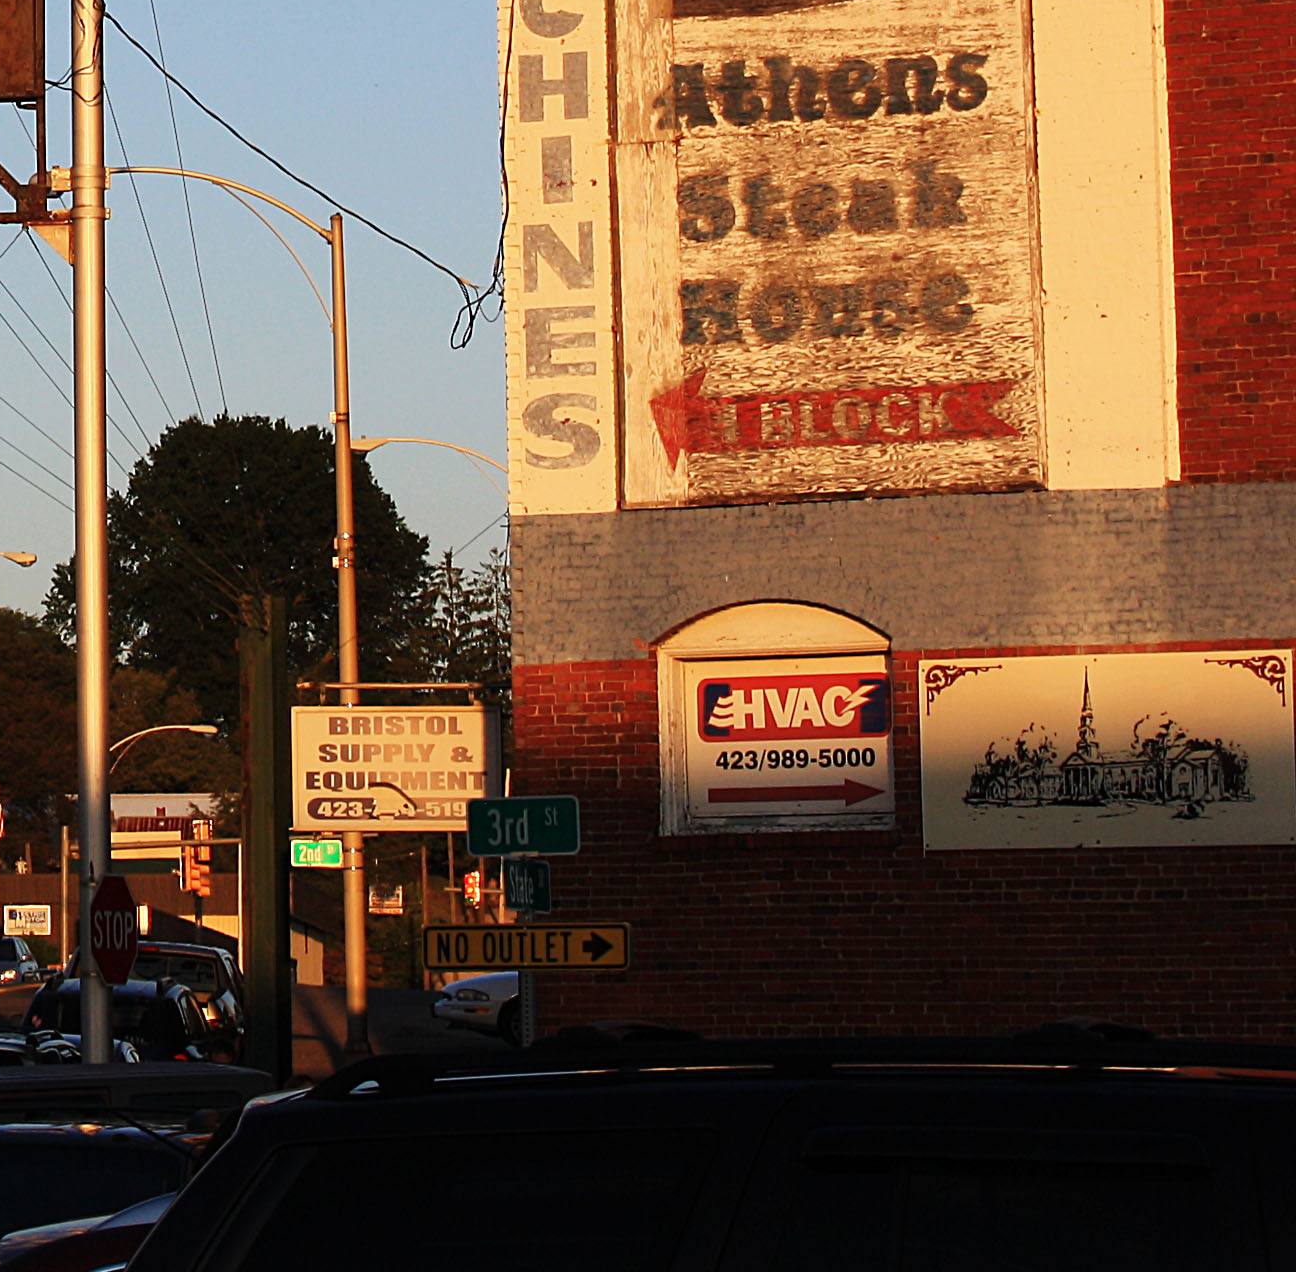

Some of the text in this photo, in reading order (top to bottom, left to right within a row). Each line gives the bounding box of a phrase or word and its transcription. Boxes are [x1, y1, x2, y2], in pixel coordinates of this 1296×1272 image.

[654, 51, 990, 130] Athens
[677, 162, 967, 243] Steak
[681, 271, 975, 346] House
[760, 392, 951, 442] BLOCK
[328, 716, 463, 736] BRISTOL
[711, 684, 876, 730] HVAC
[319, 744, 474, 763] SUPPLY &
[715, 747, 876, 770] 423/989-5000
[487, 808, 558, 846] 3rd St
[299, 844, 321, 862] 2nd
[509, 865, 534, 905] State
[94, 910, 134, 950] STOP
[436, 932, 572, 964] NO OUTLET
